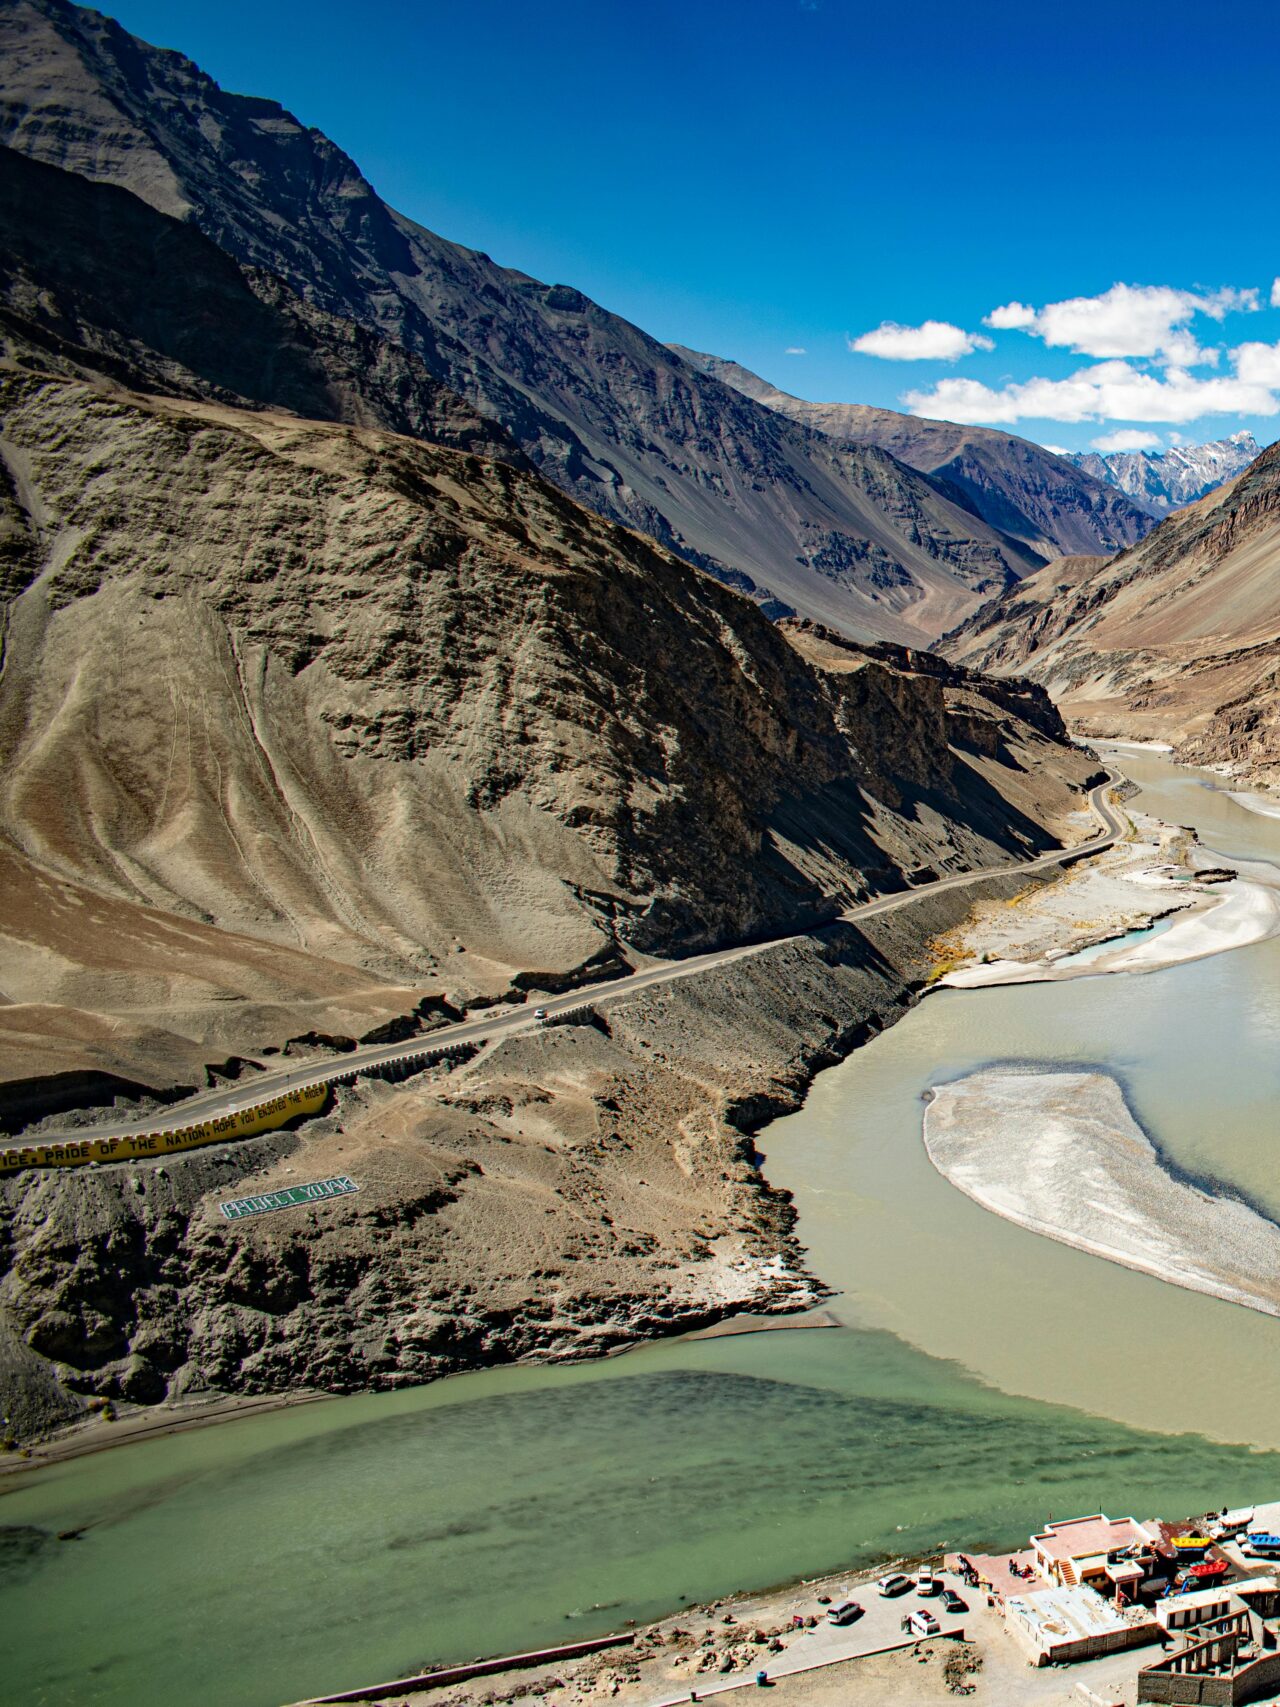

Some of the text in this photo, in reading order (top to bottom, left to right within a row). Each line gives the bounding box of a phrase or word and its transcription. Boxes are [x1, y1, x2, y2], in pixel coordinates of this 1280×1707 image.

[0, 1154, 37, 1166] ICE.
[45, 1147, 90, 1162] PRIDE
[100, 1143, 118, 1155] OF
[129, 1139, 157, 1151] THE
[166, 1129, 210, 1146] NATION.
[213, 1119, 237, 1134] HOPE
[241, 1113, 255, 1125] YOU
[258, 1101, 287, 1119] ENJOYED
[288, 1093, 302, 1105] THE
[225, 1177, 352, 1217] PROJECT YOJAK
